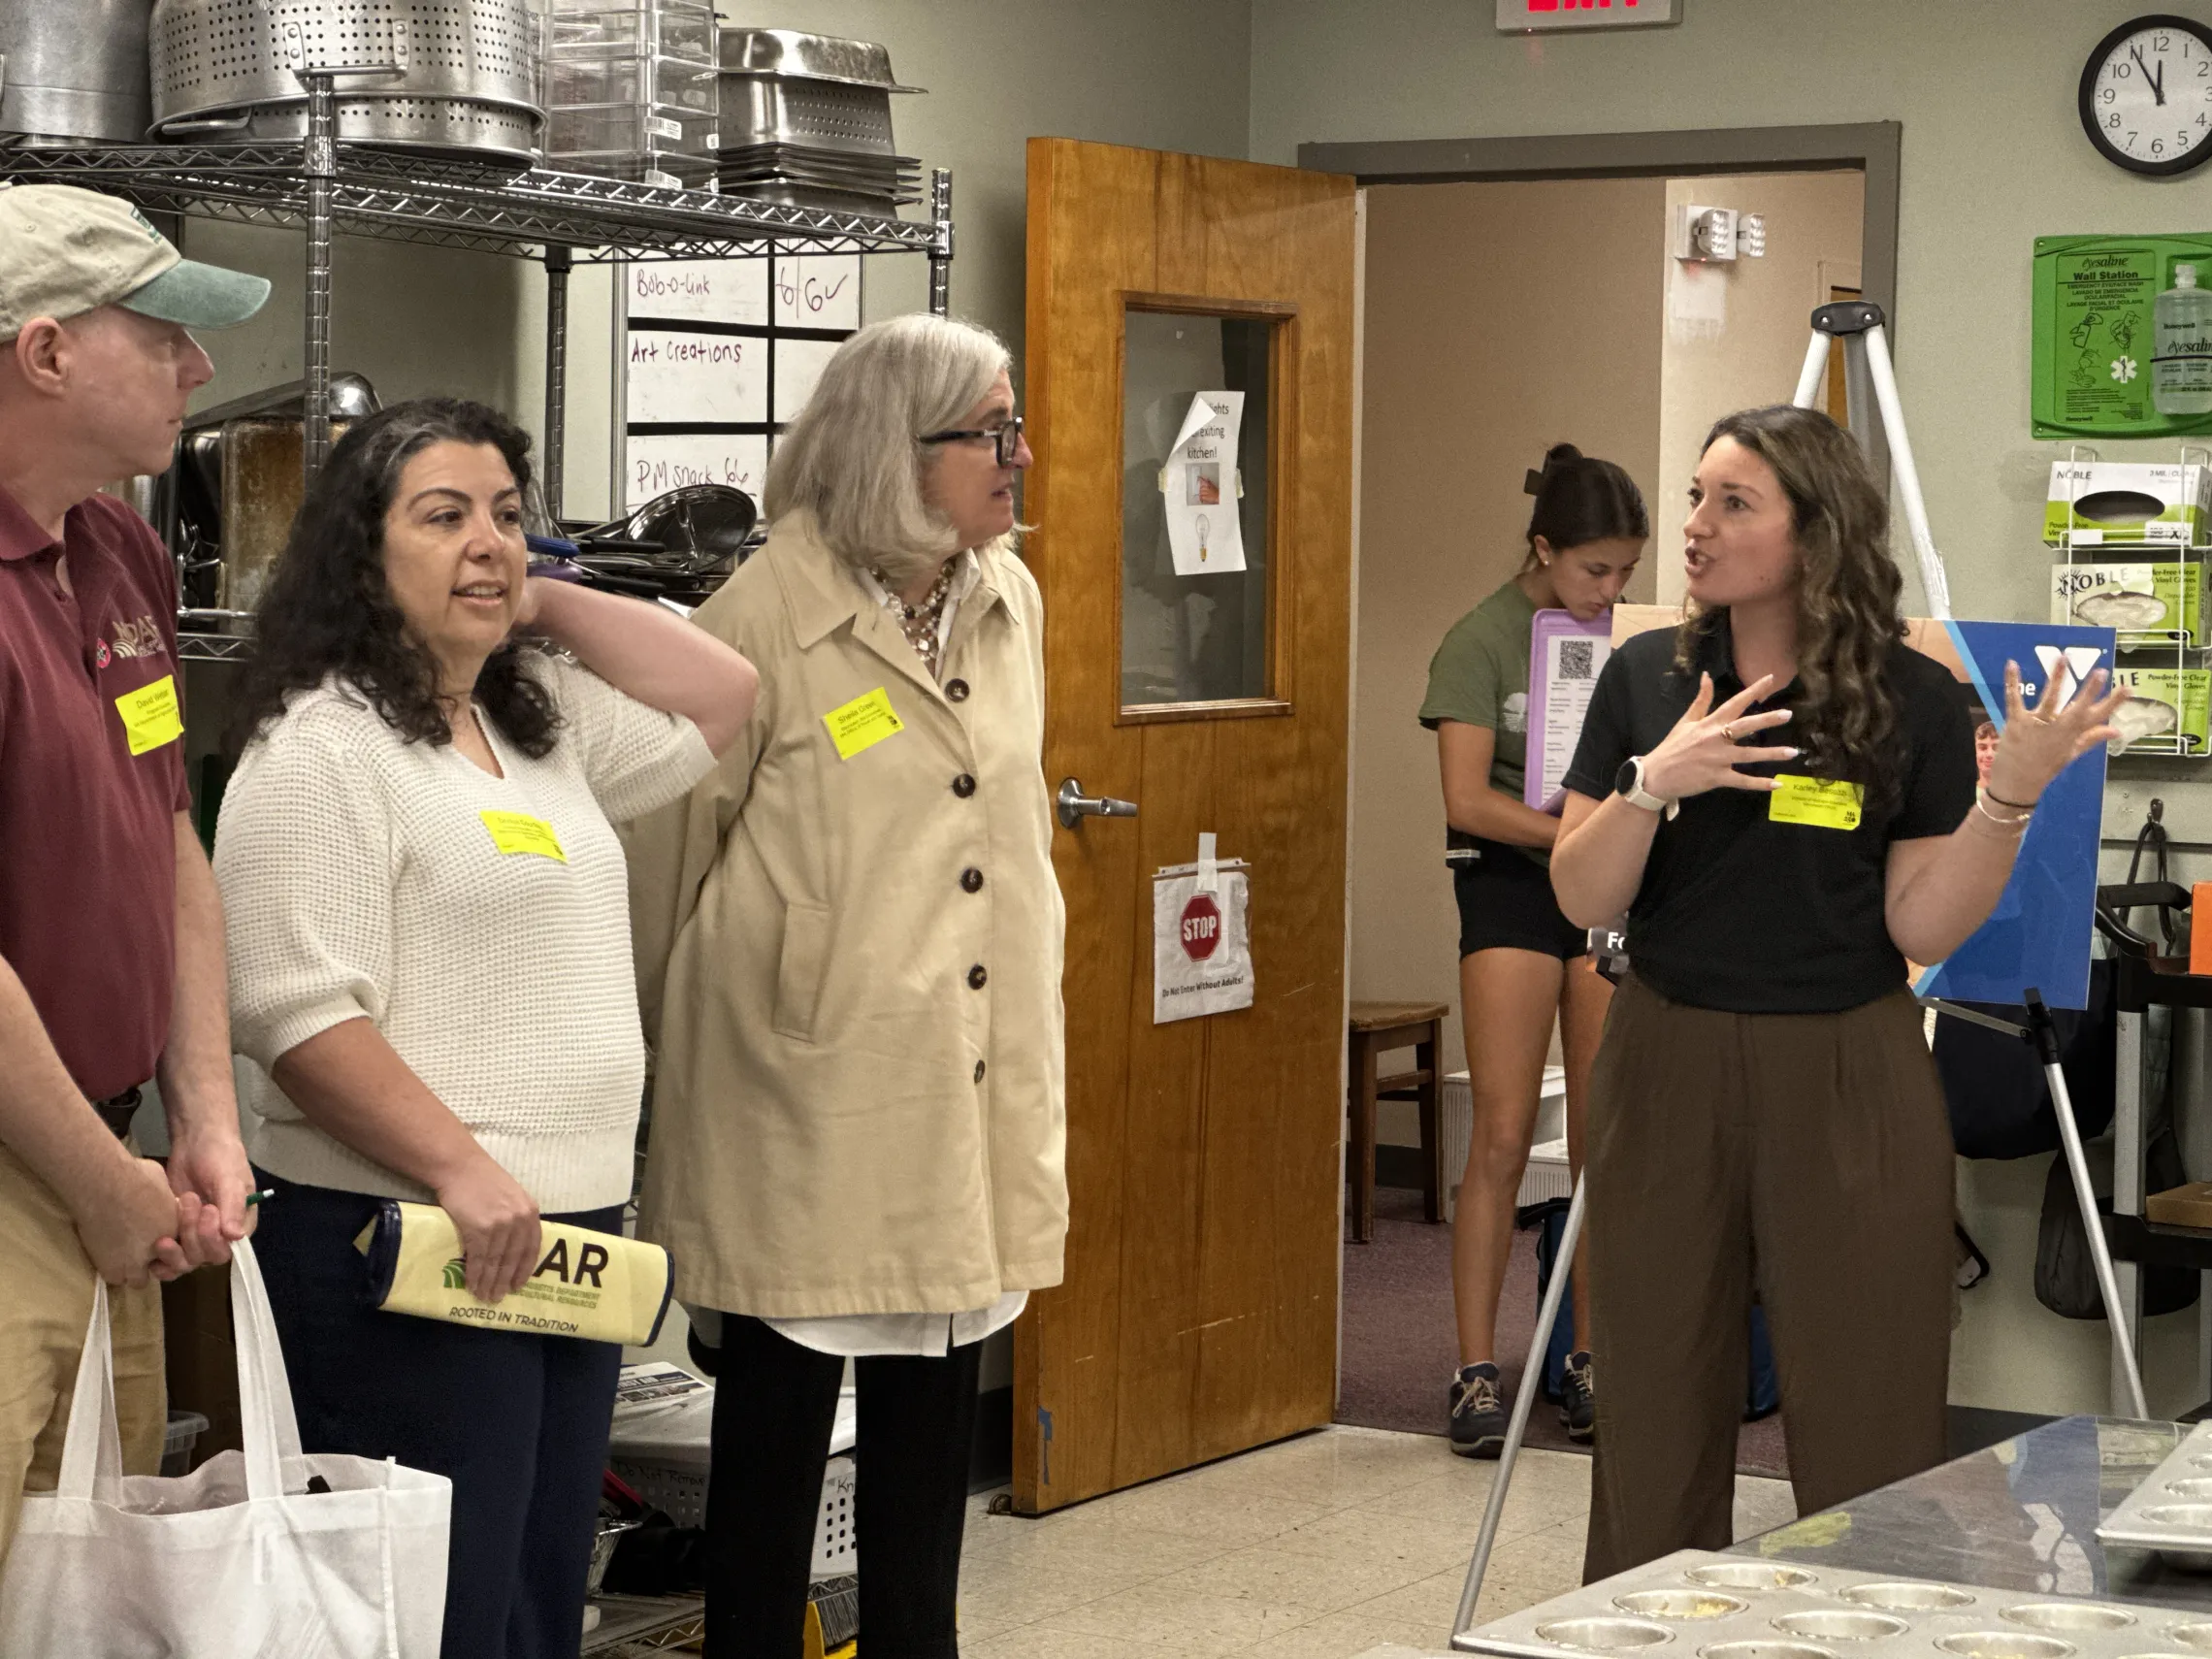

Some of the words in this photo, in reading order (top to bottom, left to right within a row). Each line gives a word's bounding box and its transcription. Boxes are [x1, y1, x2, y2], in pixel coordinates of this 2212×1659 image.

[2154, 36, 2169, 51] 12
[2184, 44, 2189, 58] 1
[2112, 63, 2131, 79] 10
[2197, 61, 2209, 77] 2
[2103, 88, 2116, 104] 9
[2109, 113, 2122, 128] 8
[2195, 112, 2207, 127] 4
[2127, 132, 2138, 146] 7
[2151, 139, 2163, 153] 6
[2177, 131, 2189, 146] 5
[2073, 272, 2096, 280] Wall
[2099, 271, 2138, 279] Station
[632, 337, 659, 363] Art
[667, 340, 742, 365] Creations
[1200, 426, 1224, 439] exiting
[1187, 446, 1217, 459] kitchen!
[636, 460, 667, 493] PM
[1183, 915, 1217, 942] STOP
[1196, 980, 1220, 991] Without
[1221, 976, 1244, 987] Adults!
[449, 1307, 497, 1321] ROOTED
[498, 1312, 512, 1322] IN
[515, 1315, 579, 1333] TRADITION
